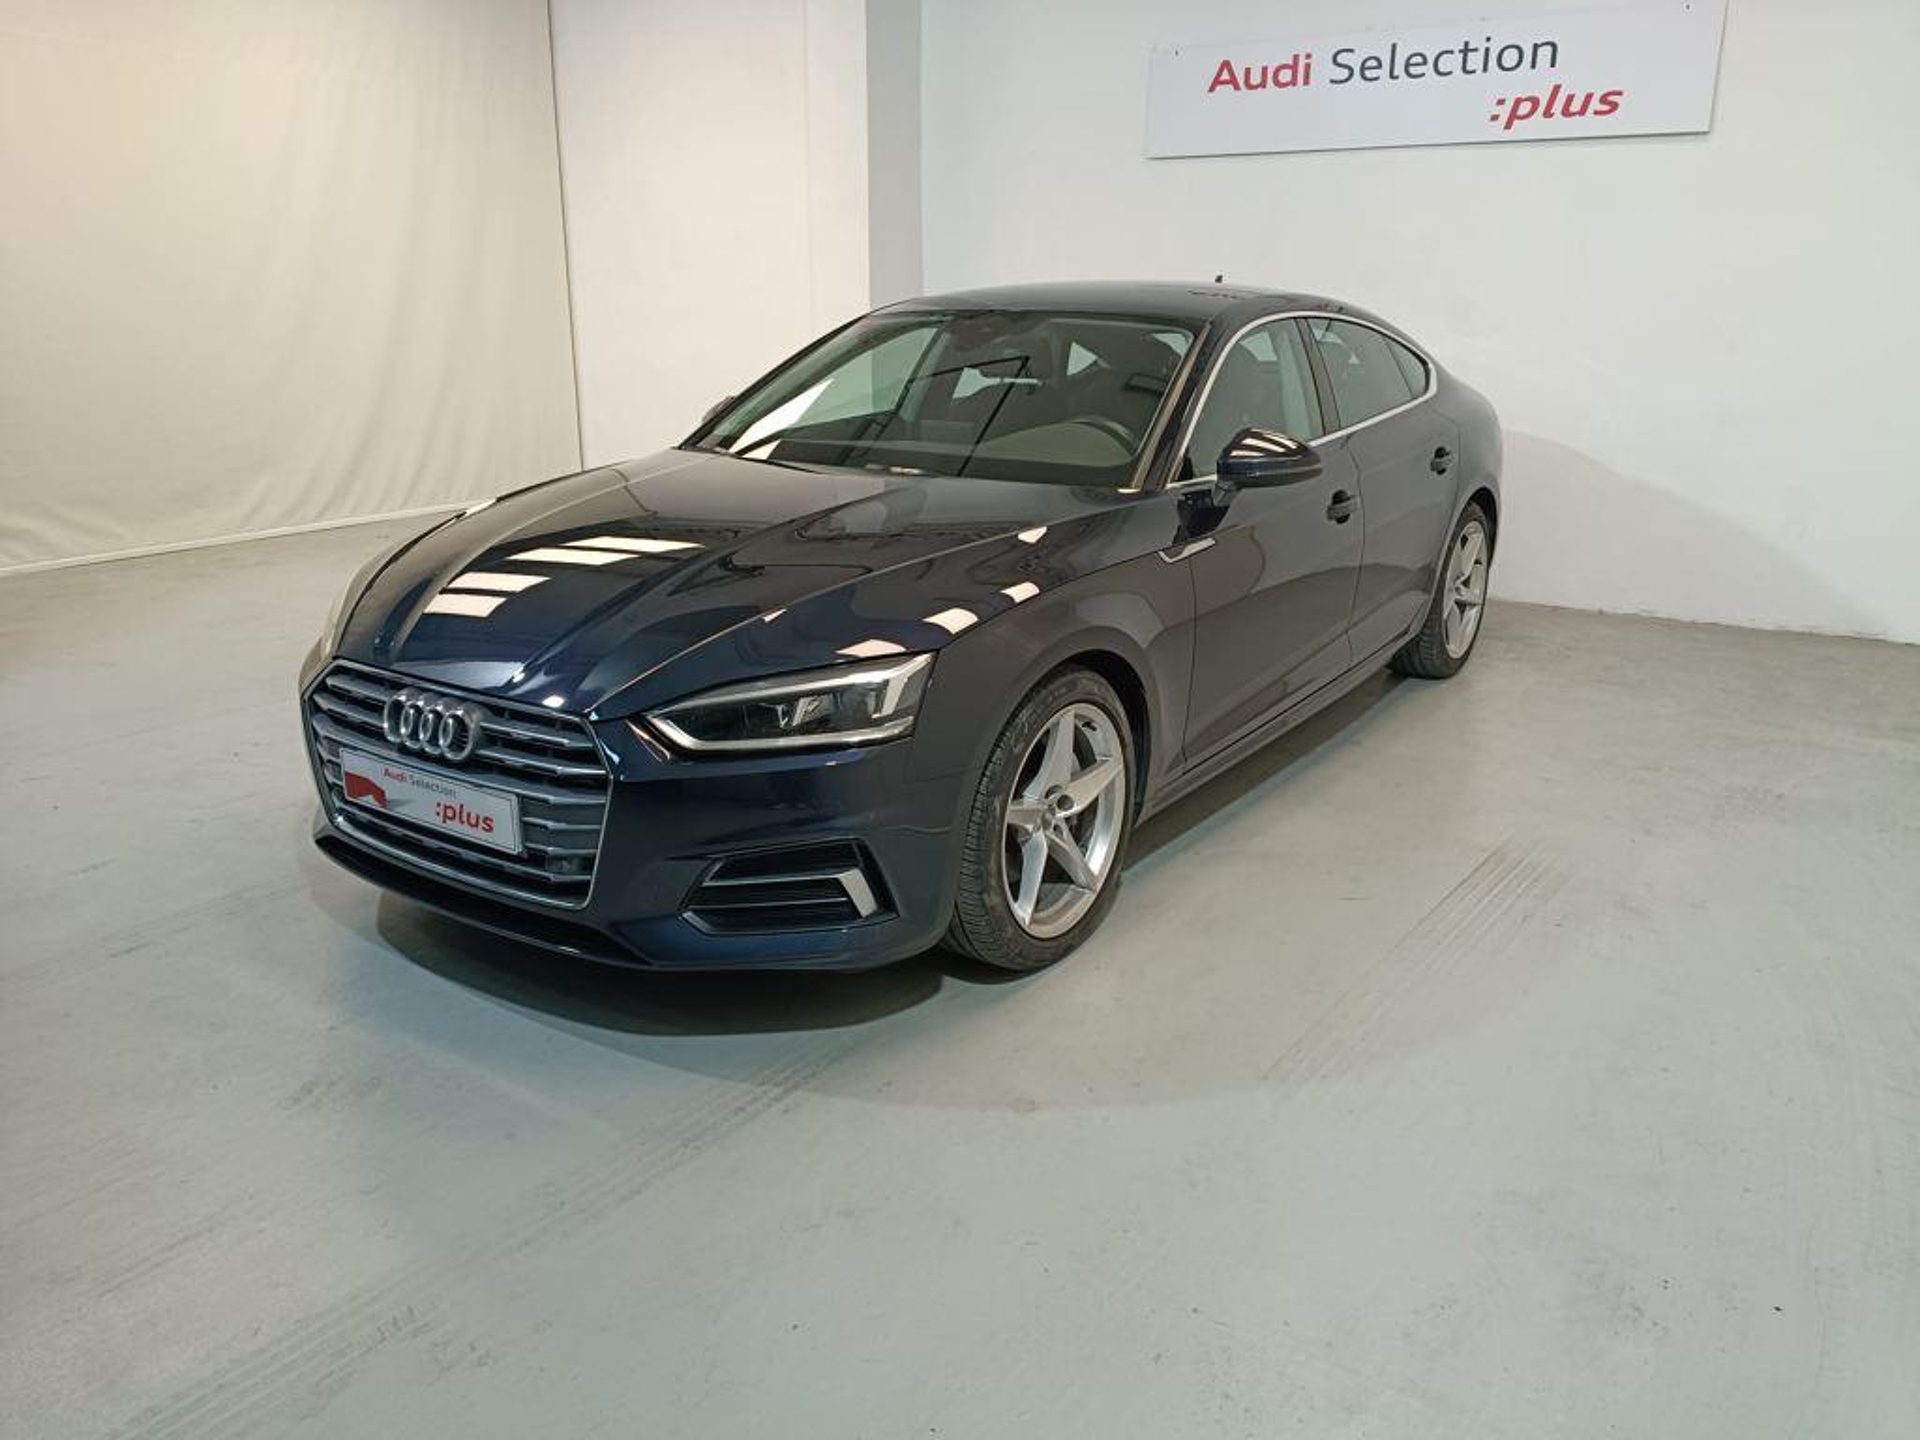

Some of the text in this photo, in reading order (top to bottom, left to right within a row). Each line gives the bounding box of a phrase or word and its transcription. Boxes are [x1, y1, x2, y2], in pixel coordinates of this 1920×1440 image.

[1208, 37, 1558, 92] Audi Selection
[1489, 84, 1624, 130] :plus
[383, 767, 456, 799] Audi Selection
[436, 801, 494, 833] :plus
